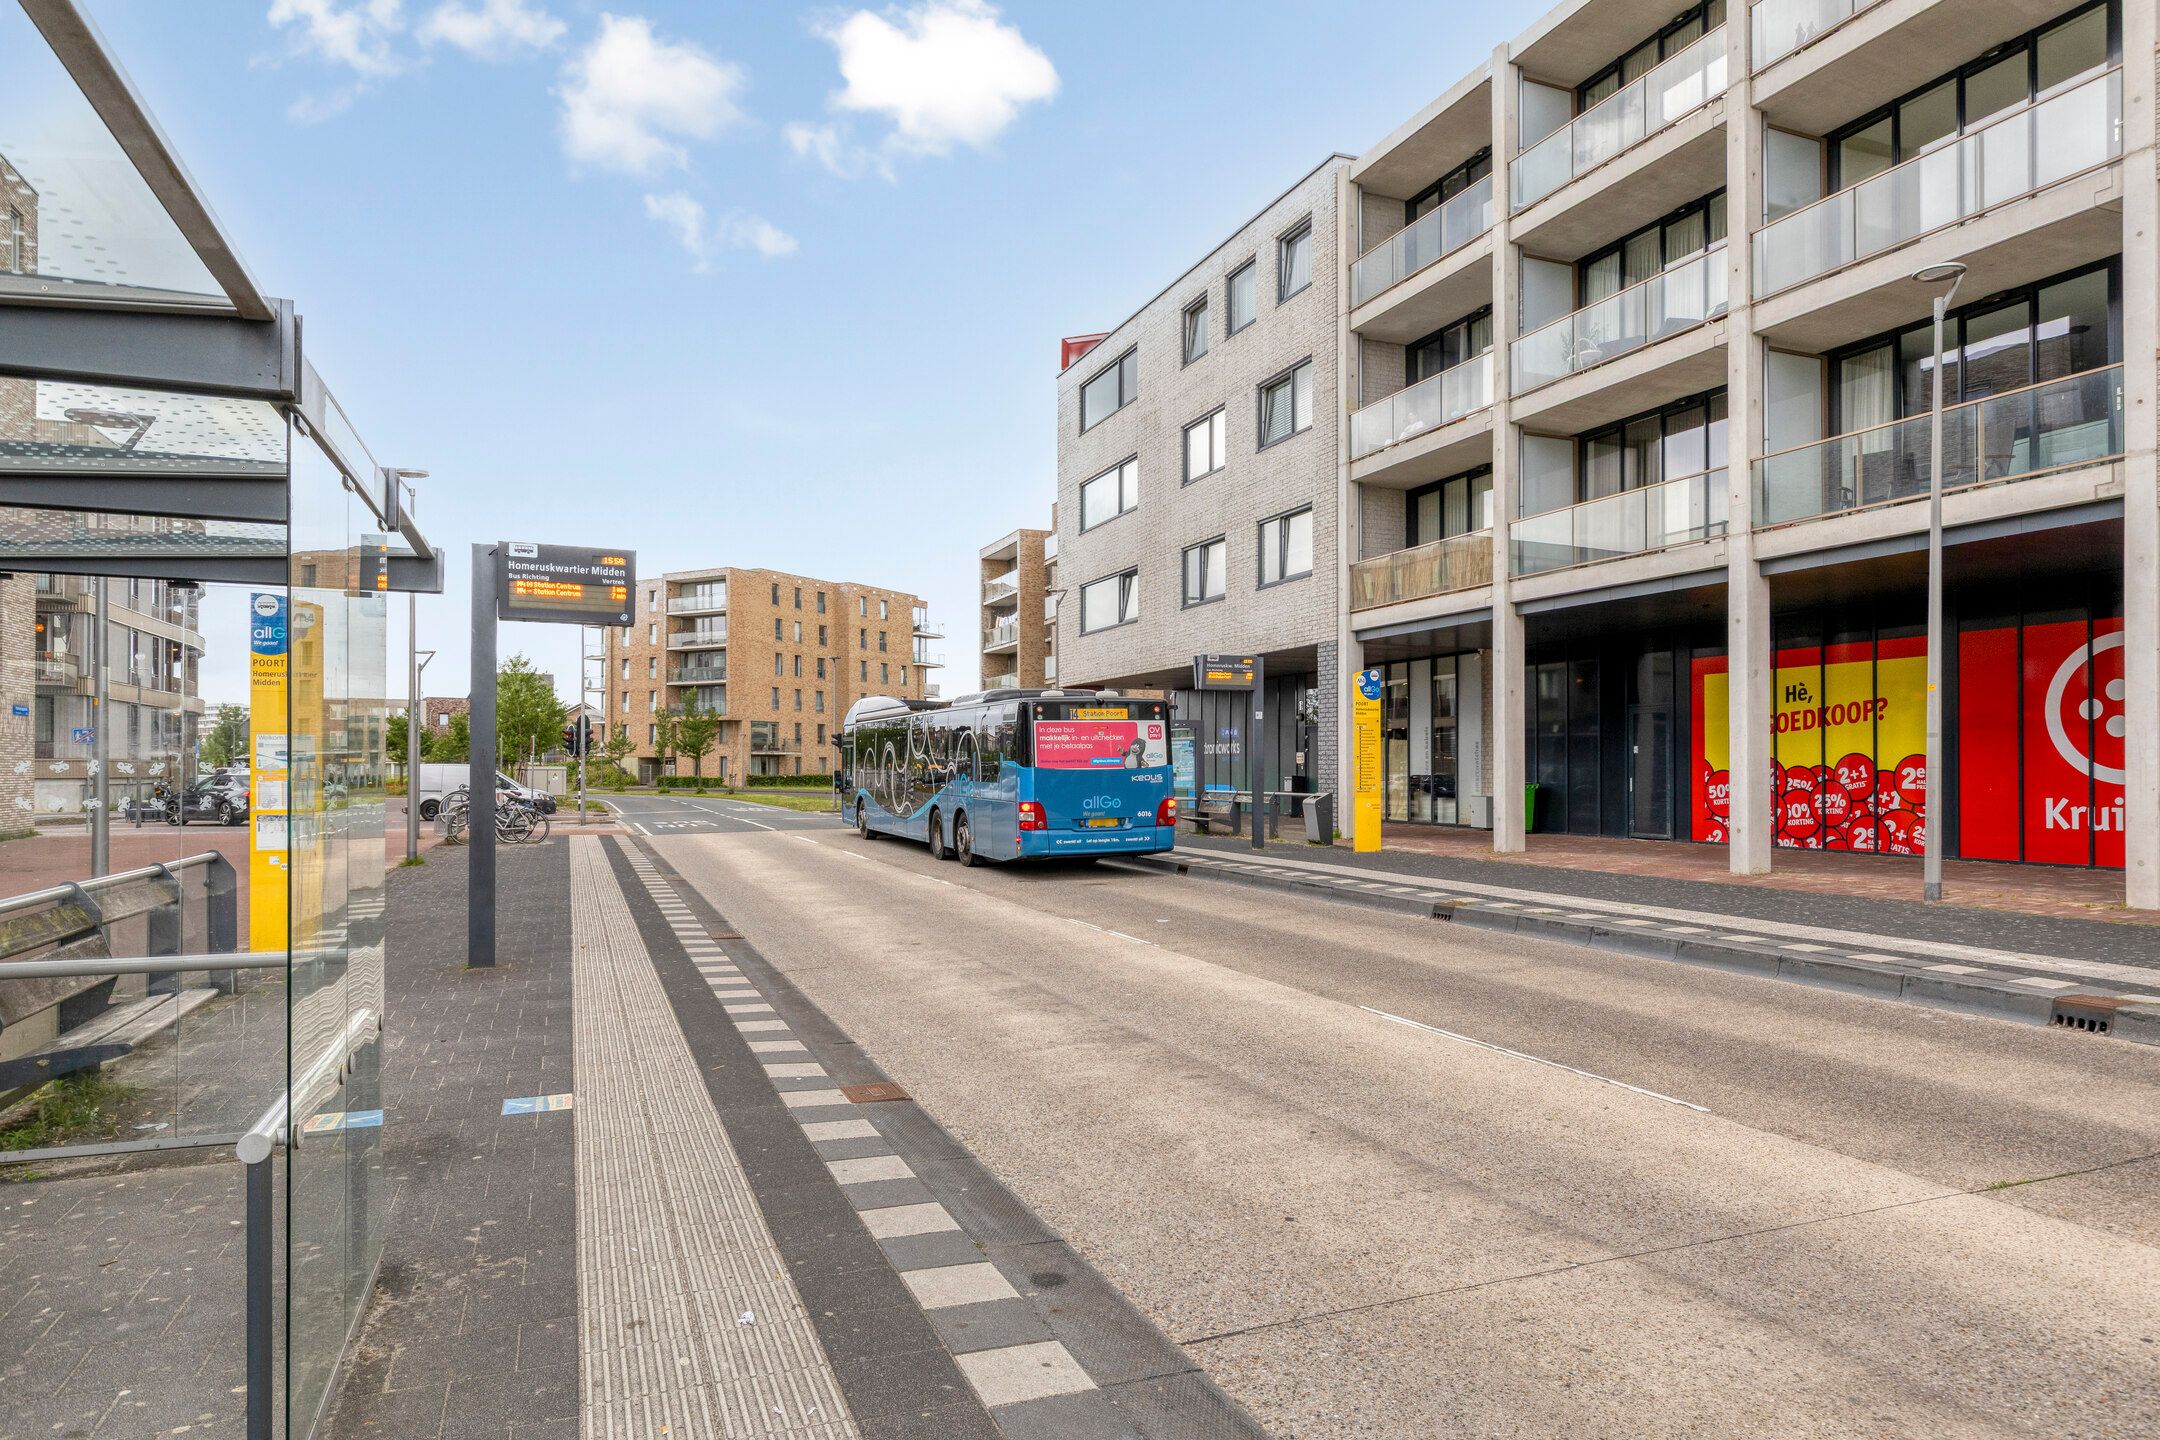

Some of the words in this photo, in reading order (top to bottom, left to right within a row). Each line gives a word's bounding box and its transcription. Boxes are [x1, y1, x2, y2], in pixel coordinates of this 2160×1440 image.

[508, 560, 590, 575] Homeruskwartier
[591, 566, 626, 577] Midden
[522, 573, 550, 582] Richting
[602, 578, 625, 586] Vertrek
[533, 581, 555, 589] Station
[556, 582, 582, 591] Centrum
[533, 588, 555, 596] Station
[253, 626, 287, 639] allG
[252, 659, 285, 667] POORT
[1363, 685, 1380, 693] allGo
[1785, 682, 1813, 704] Hè,
[1837, 764, 1868, 785] 2+1
[1083, 795, 1121, 809] allGo
[1814, 793, 1847, 808] 25%
[1818, 807, 1844, 815] KRTING
[2045, 796, 2124, 832] Krui
[1787, 818, 1814, 826] KORTING
